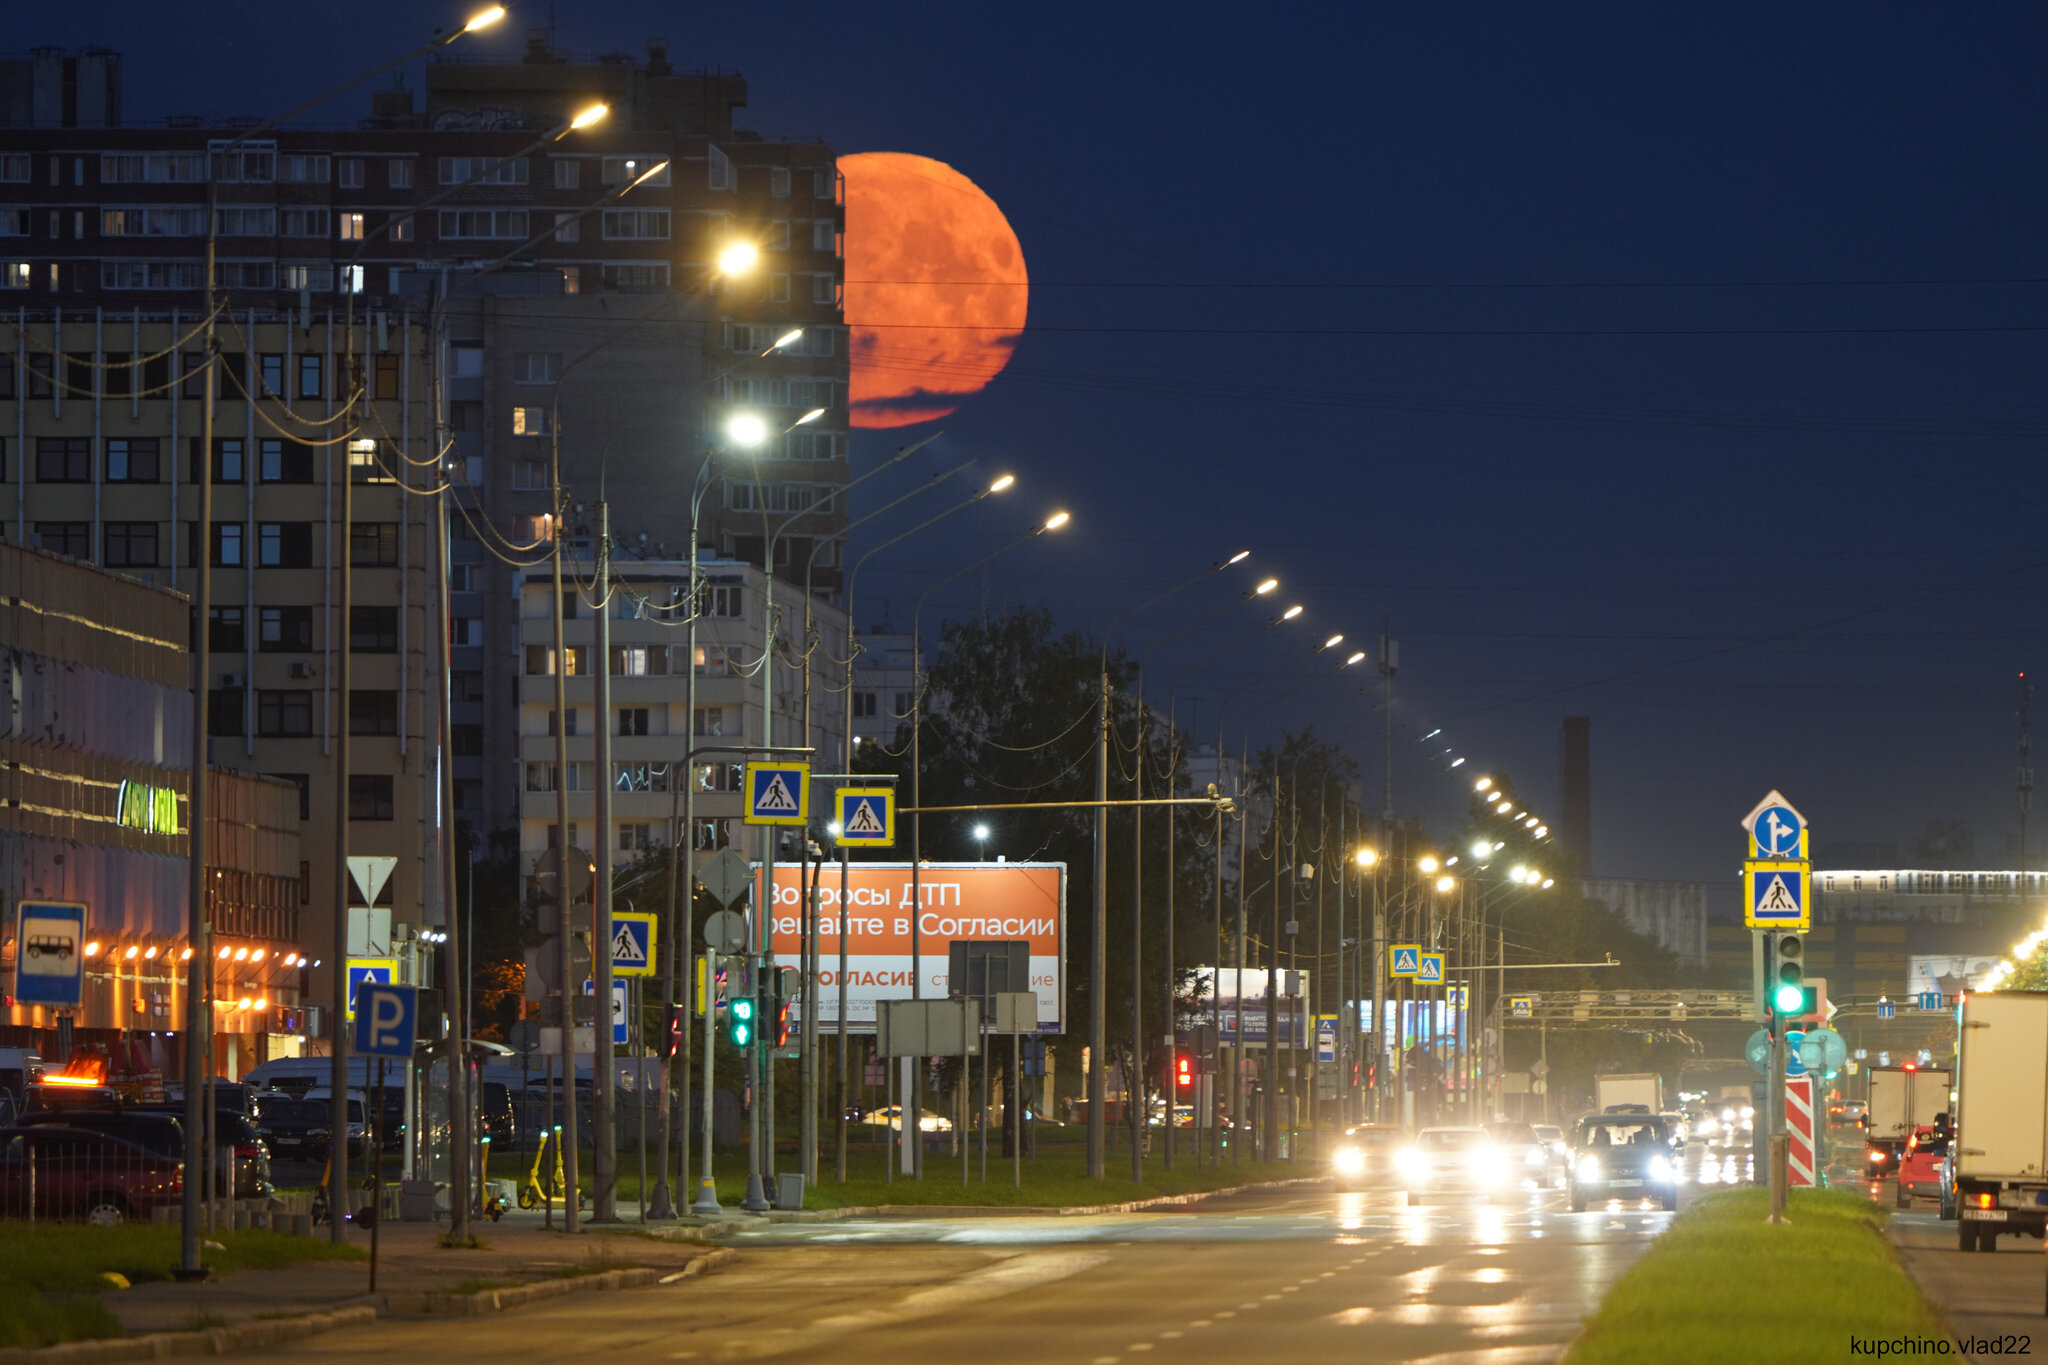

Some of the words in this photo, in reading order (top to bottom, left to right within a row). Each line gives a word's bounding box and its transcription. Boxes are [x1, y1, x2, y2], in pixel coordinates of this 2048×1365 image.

[773, 882, 890, 911] Воросы
[899, 882, 961, 909] ДТП
[894, 918, 909, 935] в
[919, 913, 1054, 936] Согласии
